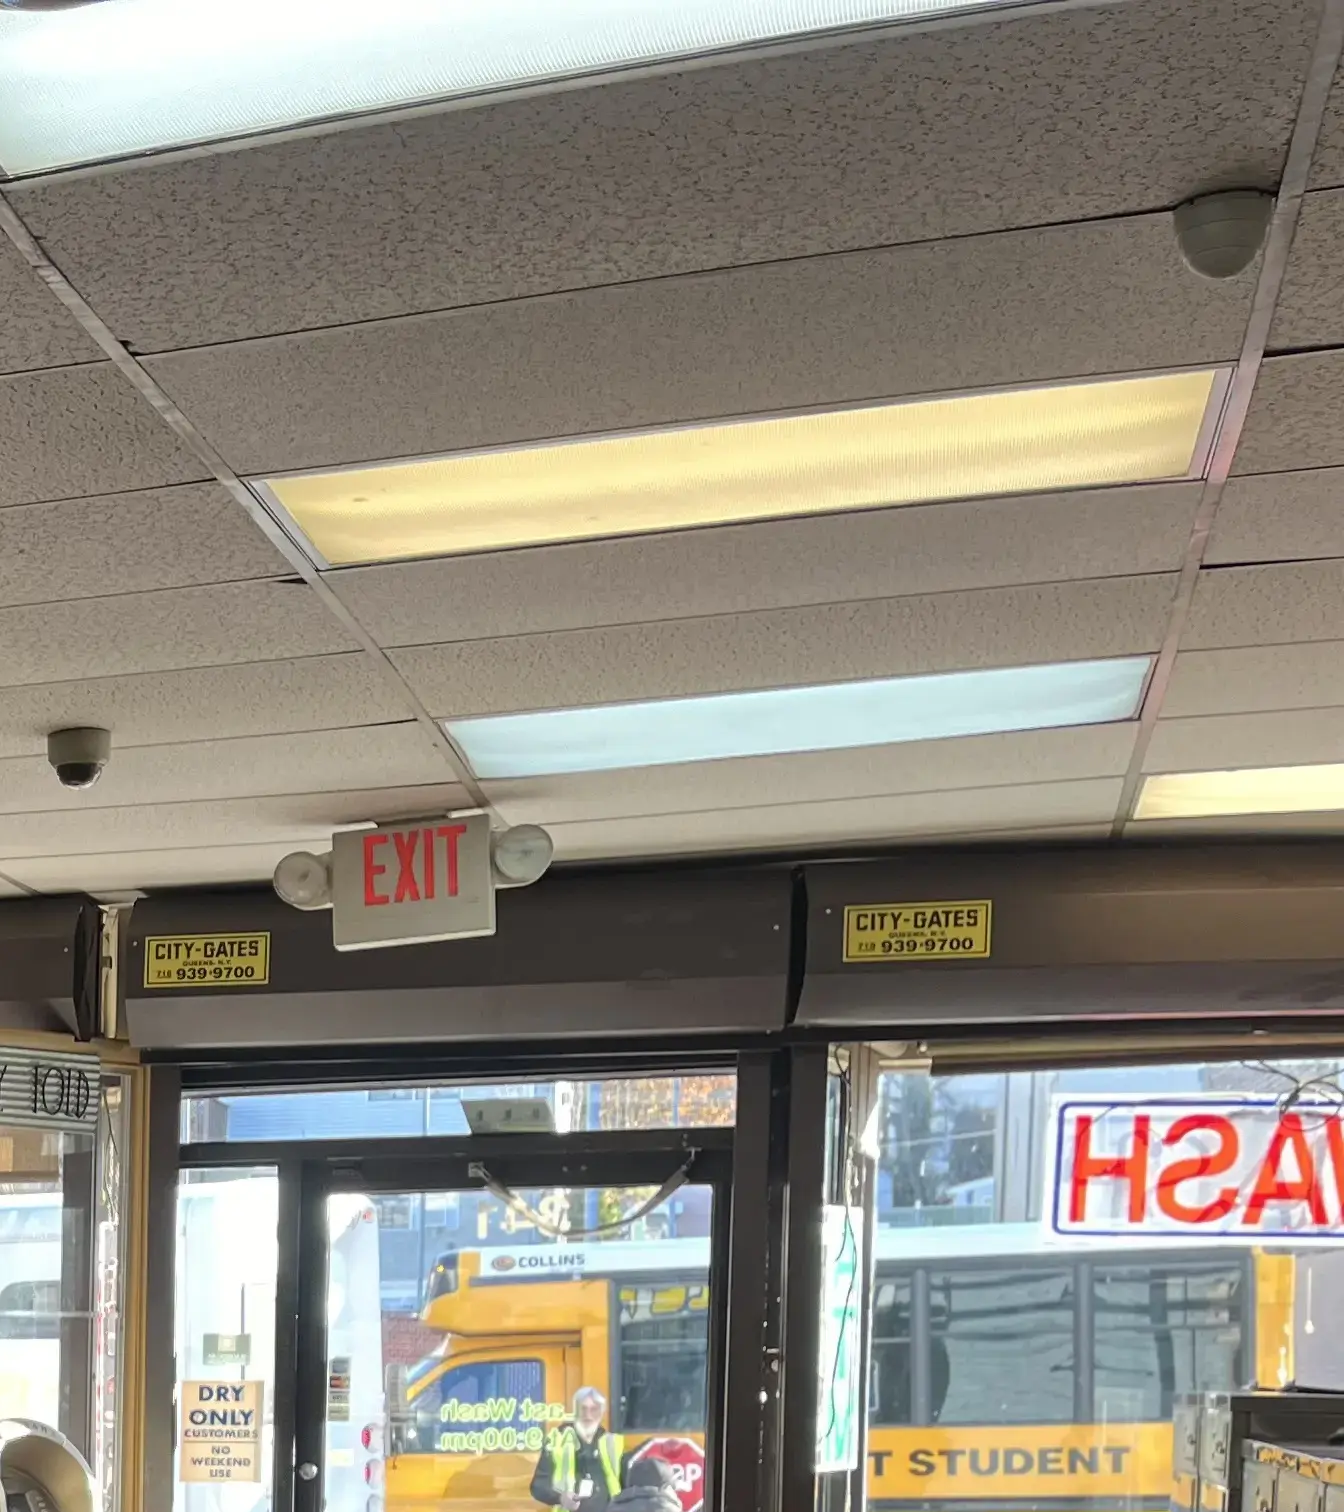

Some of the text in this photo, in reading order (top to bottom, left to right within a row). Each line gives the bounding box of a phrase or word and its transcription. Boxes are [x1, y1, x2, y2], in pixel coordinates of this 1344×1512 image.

[363, 824, 467, 906] EXIT
[856, 909, 978, 931] CITY-GATES
[155, 940, 259, 960] CITY-GATES
[518, 1254, 585, 1269] COLLINS
[198, 1384, 245, 1402] DRY
[189, 1408, 255, 1426] ONLY
[184, 1428, 259, 1439] CUSTOMERS
[211, 1445, 231, 1455] NO
[191, 1457, 251, 1466] WEEKEND
[909, 1446, 1131, 1477] STUDENT
[209, 1468, 232, 1478] USE
